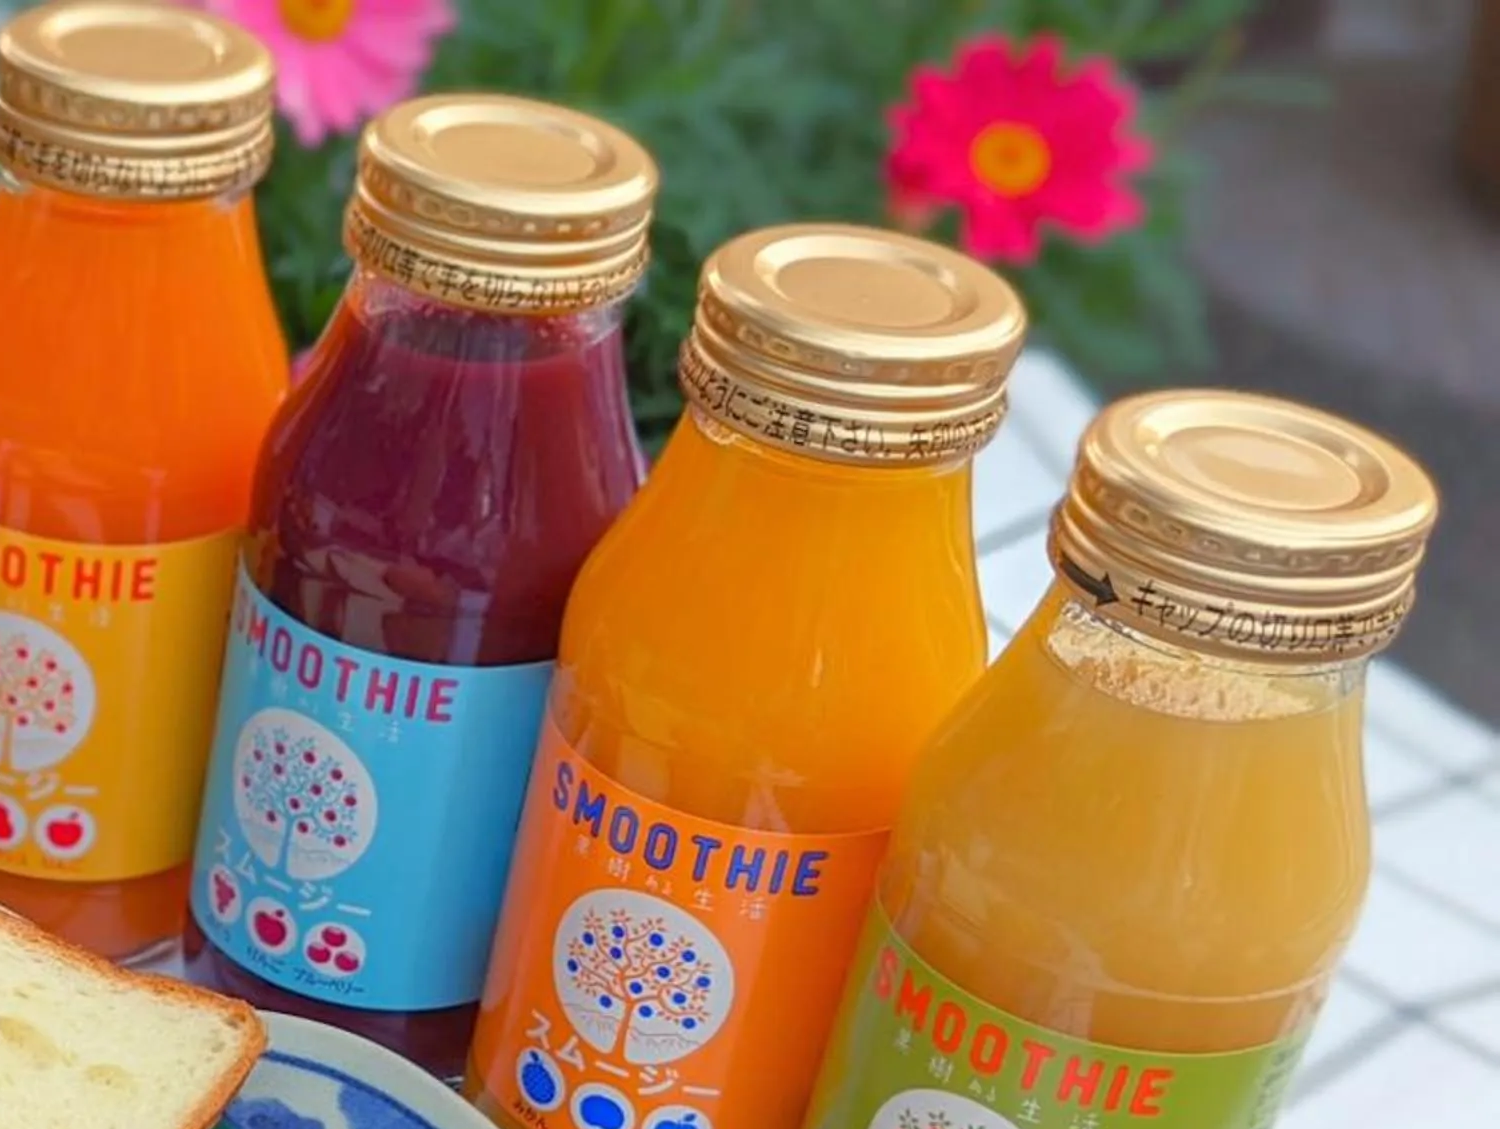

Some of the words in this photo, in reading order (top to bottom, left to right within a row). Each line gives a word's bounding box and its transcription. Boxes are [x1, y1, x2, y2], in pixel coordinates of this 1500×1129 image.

[236, 586, 460, 723] SMOOTHIE
[215, 824, 373, 916] スムージー
[552, 761, 830, 896] SMOOTHIE
[525, 1009, 721, 1096] スムージー
[873, 944, 1176, 1117] SMOOTHIE
